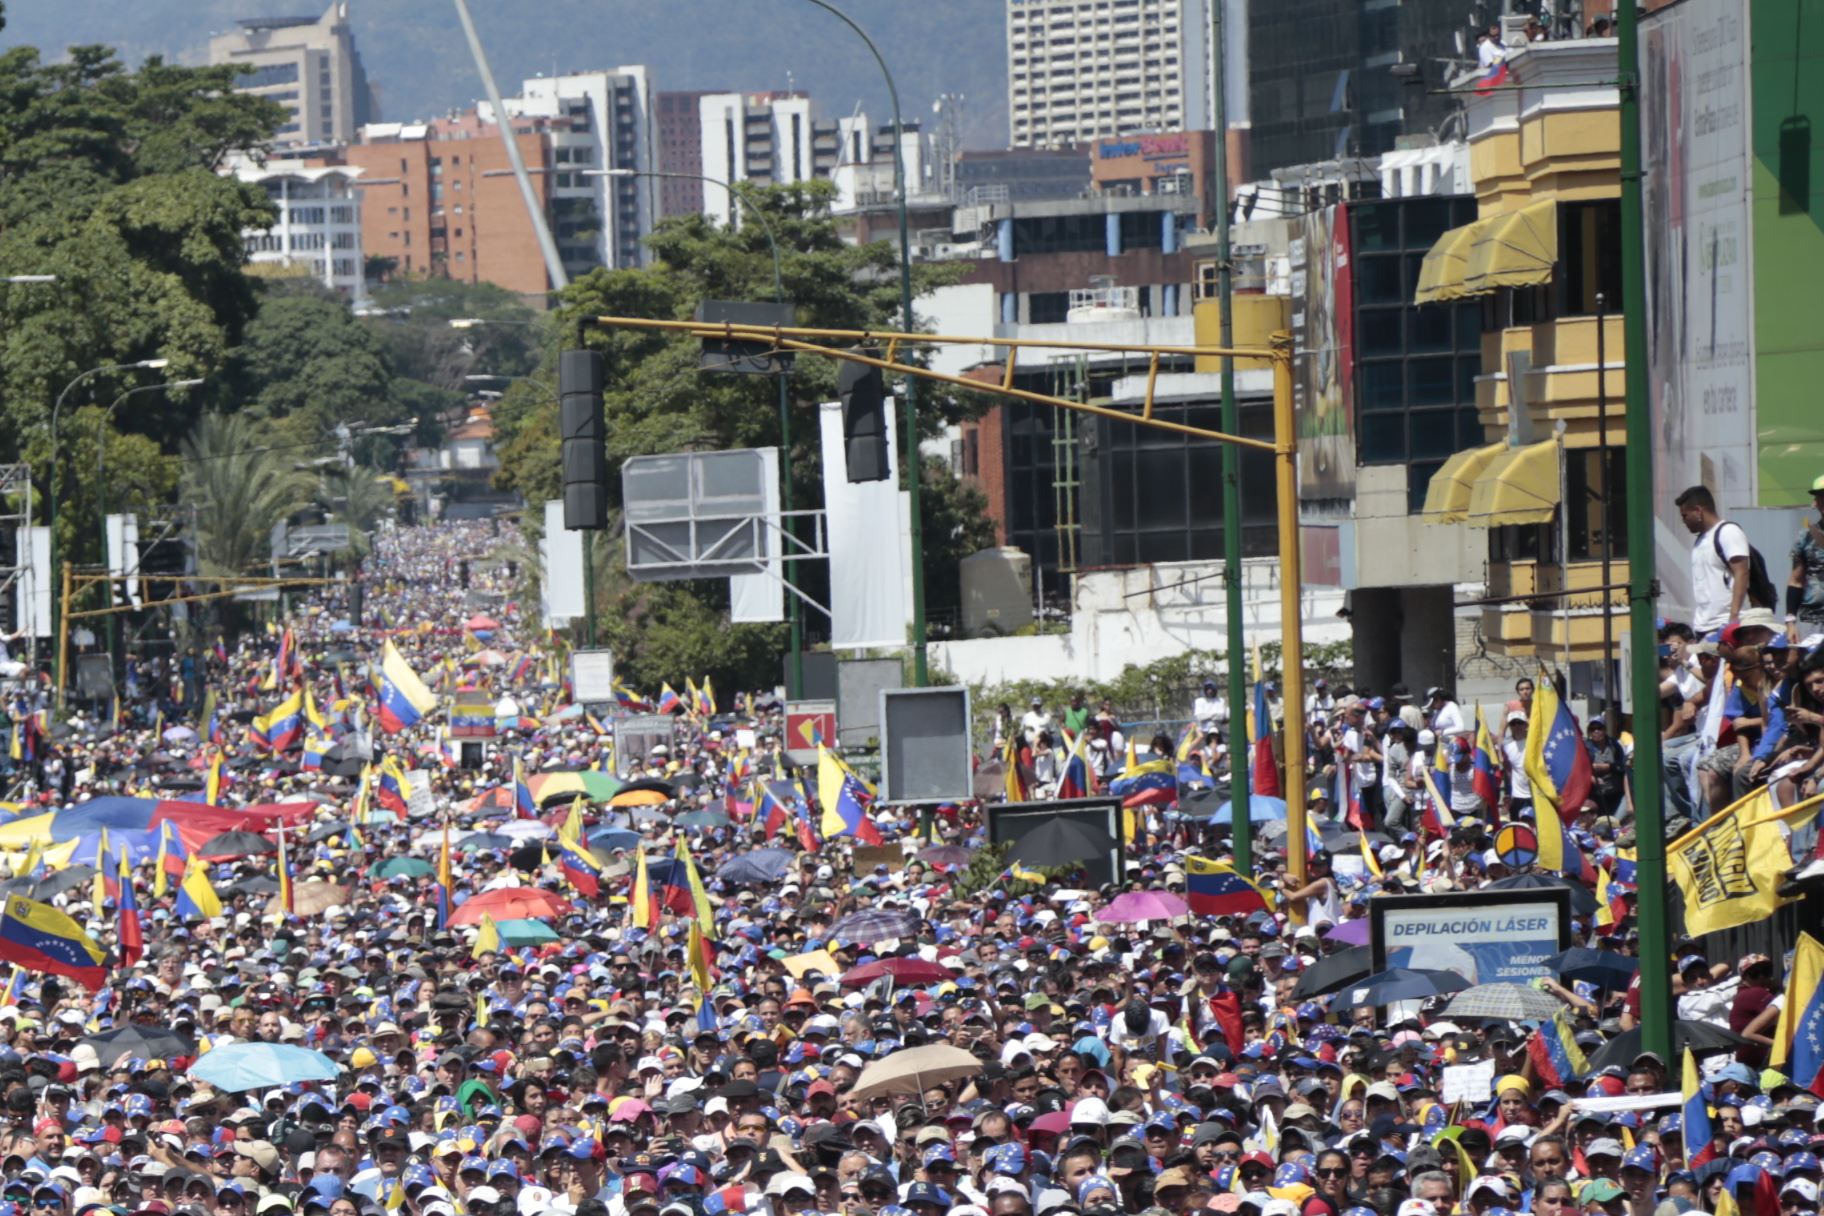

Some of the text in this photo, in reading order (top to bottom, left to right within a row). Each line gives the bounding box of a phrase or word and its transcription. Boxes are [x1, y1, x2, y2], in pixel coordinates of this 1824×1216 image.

[1392, 917, 1549, 936] DEPILACIÓN LÁSER
[1496, 967, 1551, 977] SESIONES
